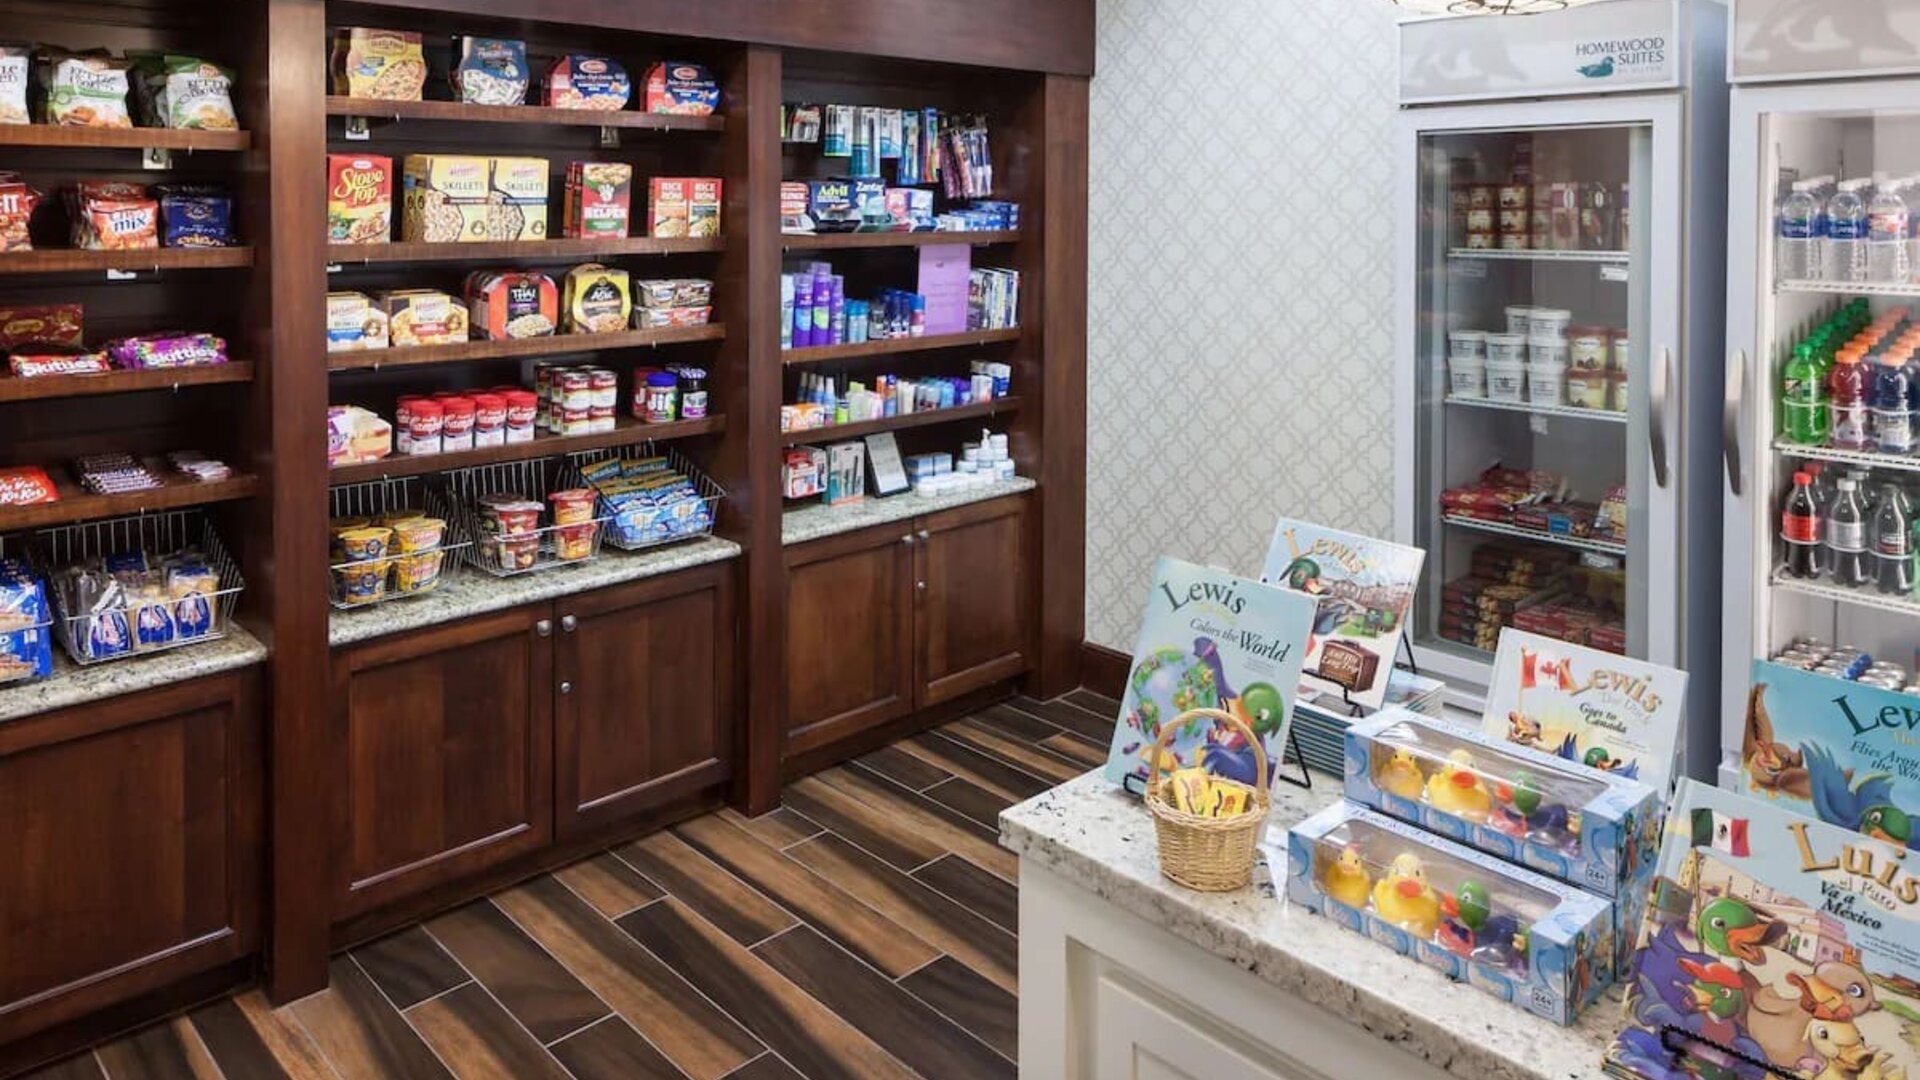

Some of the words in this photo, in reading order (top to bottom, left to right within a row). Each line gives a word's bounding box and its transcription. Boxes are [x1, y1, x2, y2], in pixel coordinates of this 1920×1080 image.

[1576, 37, 1664, 55] HOMEWOOD
[1619, 51, 1664, 65] SUITES
[334, 167, 385, 199] Stove
[443, 181, 484, 191] SKILLETS
[505, 182, 545, 192] SKILLETS
[818, 184, 848, 197] Advil
[352, 186, 378, 206] Top
[113, 217, 146, 232] mix
[511, 288, 537, 301] THAI
[147, 346, 218, 365] Skittles
[21, 360, 101, 377] Skittles
[647, 390, 675, 413] Jif
[1160, 580, 1247, 615] Lewis
[1190, 618, 1220, 638] Colors
[1221, 628, 1239, 642] the
[1239, 630, 1291, 662] World
[1558, 657, 1663, 713] Lewis
[1605, 709, 1617, 721] to
[1585, 715, 1628, 735] Canada
[1850, 740, 1881, 758] Flies
[1871, 759, 1893, 773] the
[1787, 822, 1920, 904] Luis
[1587, 868, 1606, 881] 24+
[1820, 880, 1840, 900] Va
